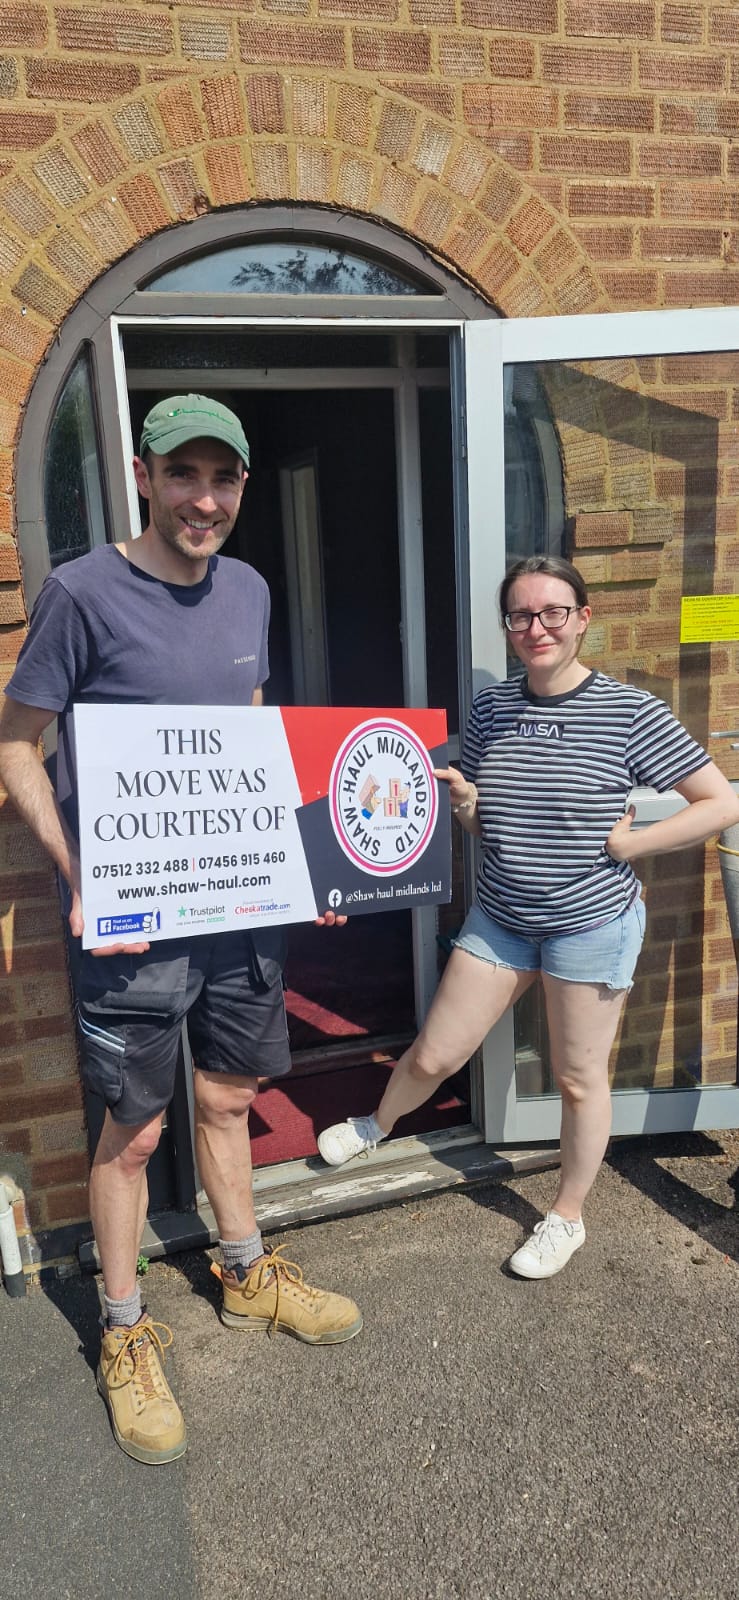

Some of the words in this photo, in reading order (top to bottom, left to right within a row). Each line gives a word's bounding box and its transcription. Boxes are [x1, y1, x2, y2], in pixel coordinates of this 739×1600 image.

[157, 728, 222, 755] THIS
[518, 723, 560, 738] NASA
[115, 769, 202, 798] MOVE
[207, 767, 267, 794] WAS
[377, 736, 427, 818] MIDLANDS
[343, 743, 381, 857] SHAW-HAUL
[94, 807, 248, 842] COURTESY
[252, 805, 286, 832] OF
[395, 822, 420, 854] LTD
[92, 863, 133, 879] 07512
[135, 861, 160, 876] 332
[163, 858, 189, 873] 488
[198, 854, 238, 870] 07456
[240, 853, 260, 866] 915
[263, 851, 286, 864] 460
[117, 874, 271, 900] www.shaw-haul.com
[345, 889, 375, 904] @Shaw
[376, 885, 394, 899] haul
[395, 883, 430, 897] midlands
[430, 881, 442, 893] ltd
[189, 906, 225, 916] Trustpilot
[113, 922, 140, 931] Facebook
